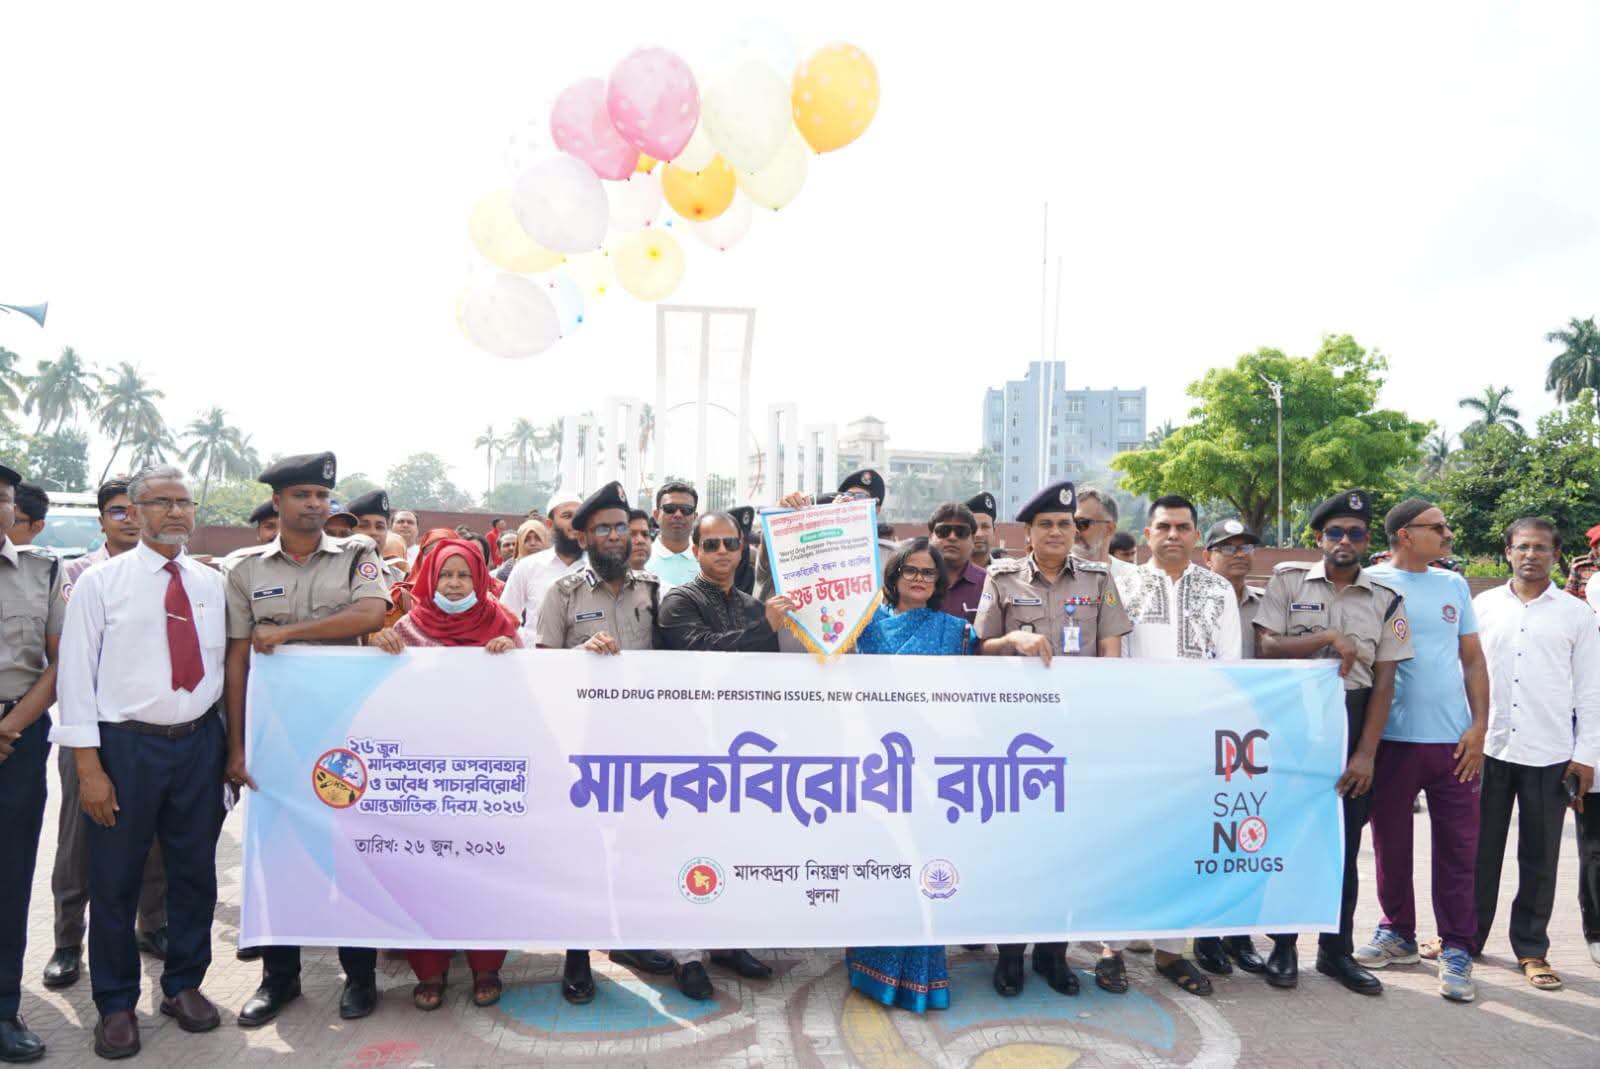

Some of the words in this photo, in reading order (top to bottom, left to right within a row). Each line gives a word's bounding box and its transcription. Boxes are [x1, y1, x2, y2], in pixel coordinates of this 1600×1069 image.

[787, 586, 813, 610] শুভ
[815, 574, 872, 602] উদ্বোধন
[577, 689, 619, 699] WORLD
[621, 689, 655, 700] DRUG
[657, 689, 715, 700] PROBLEM:
[717, 690, 782, 701] PERSISTING
[784, 690, 824, 702] ISSUES,
[827, 691, 853, 702] NEW
[855, 691, 929, 703] CHALLENGES,
[931, 692, 997, 703] INNOVATIVE
[999, 693, 1061, 704] RESPONSES
[349, 739, 374, 754] ২৬
[377, 743, 399, 758] জুন
[368, 759, 446, 774] মাদকদ্রব্যের
[451, 759, 526, 774] অপব্যবহার
[370, 778, 381, 791] ও
[385, 775, 428, 794] অবৈধ
[433, 774, 526, 794] পাচারবিরোধী
[569, 731, 915, 827] মাদকবিরোধী
[934, 733, 1067, 824] র‍্যালি
[360, 795, 437, 814] আন্তর্জাতিক
[442, 796, 478, 813] দিবস
[483, 799, 525, 814] ২০২৬
[1213, 791, 1267, 817] SAY
[355, 834, 398, 853] তারিখ:
[404, 839, 425, 854] ২৬
[465, 840, 505, 856] ২০২৬
[733, 865, 800, 882] মাদকদ্রব্য
[805, 859, 849, 880] নিয়ন্ত্রণ
[852, 858, 912, 880] অধিদপ্তর
[1194, 859, 1218, 875] TO
[1223, 857, 1284, 873] DRUGS
[806, 887, 840, 906] খুলনা
